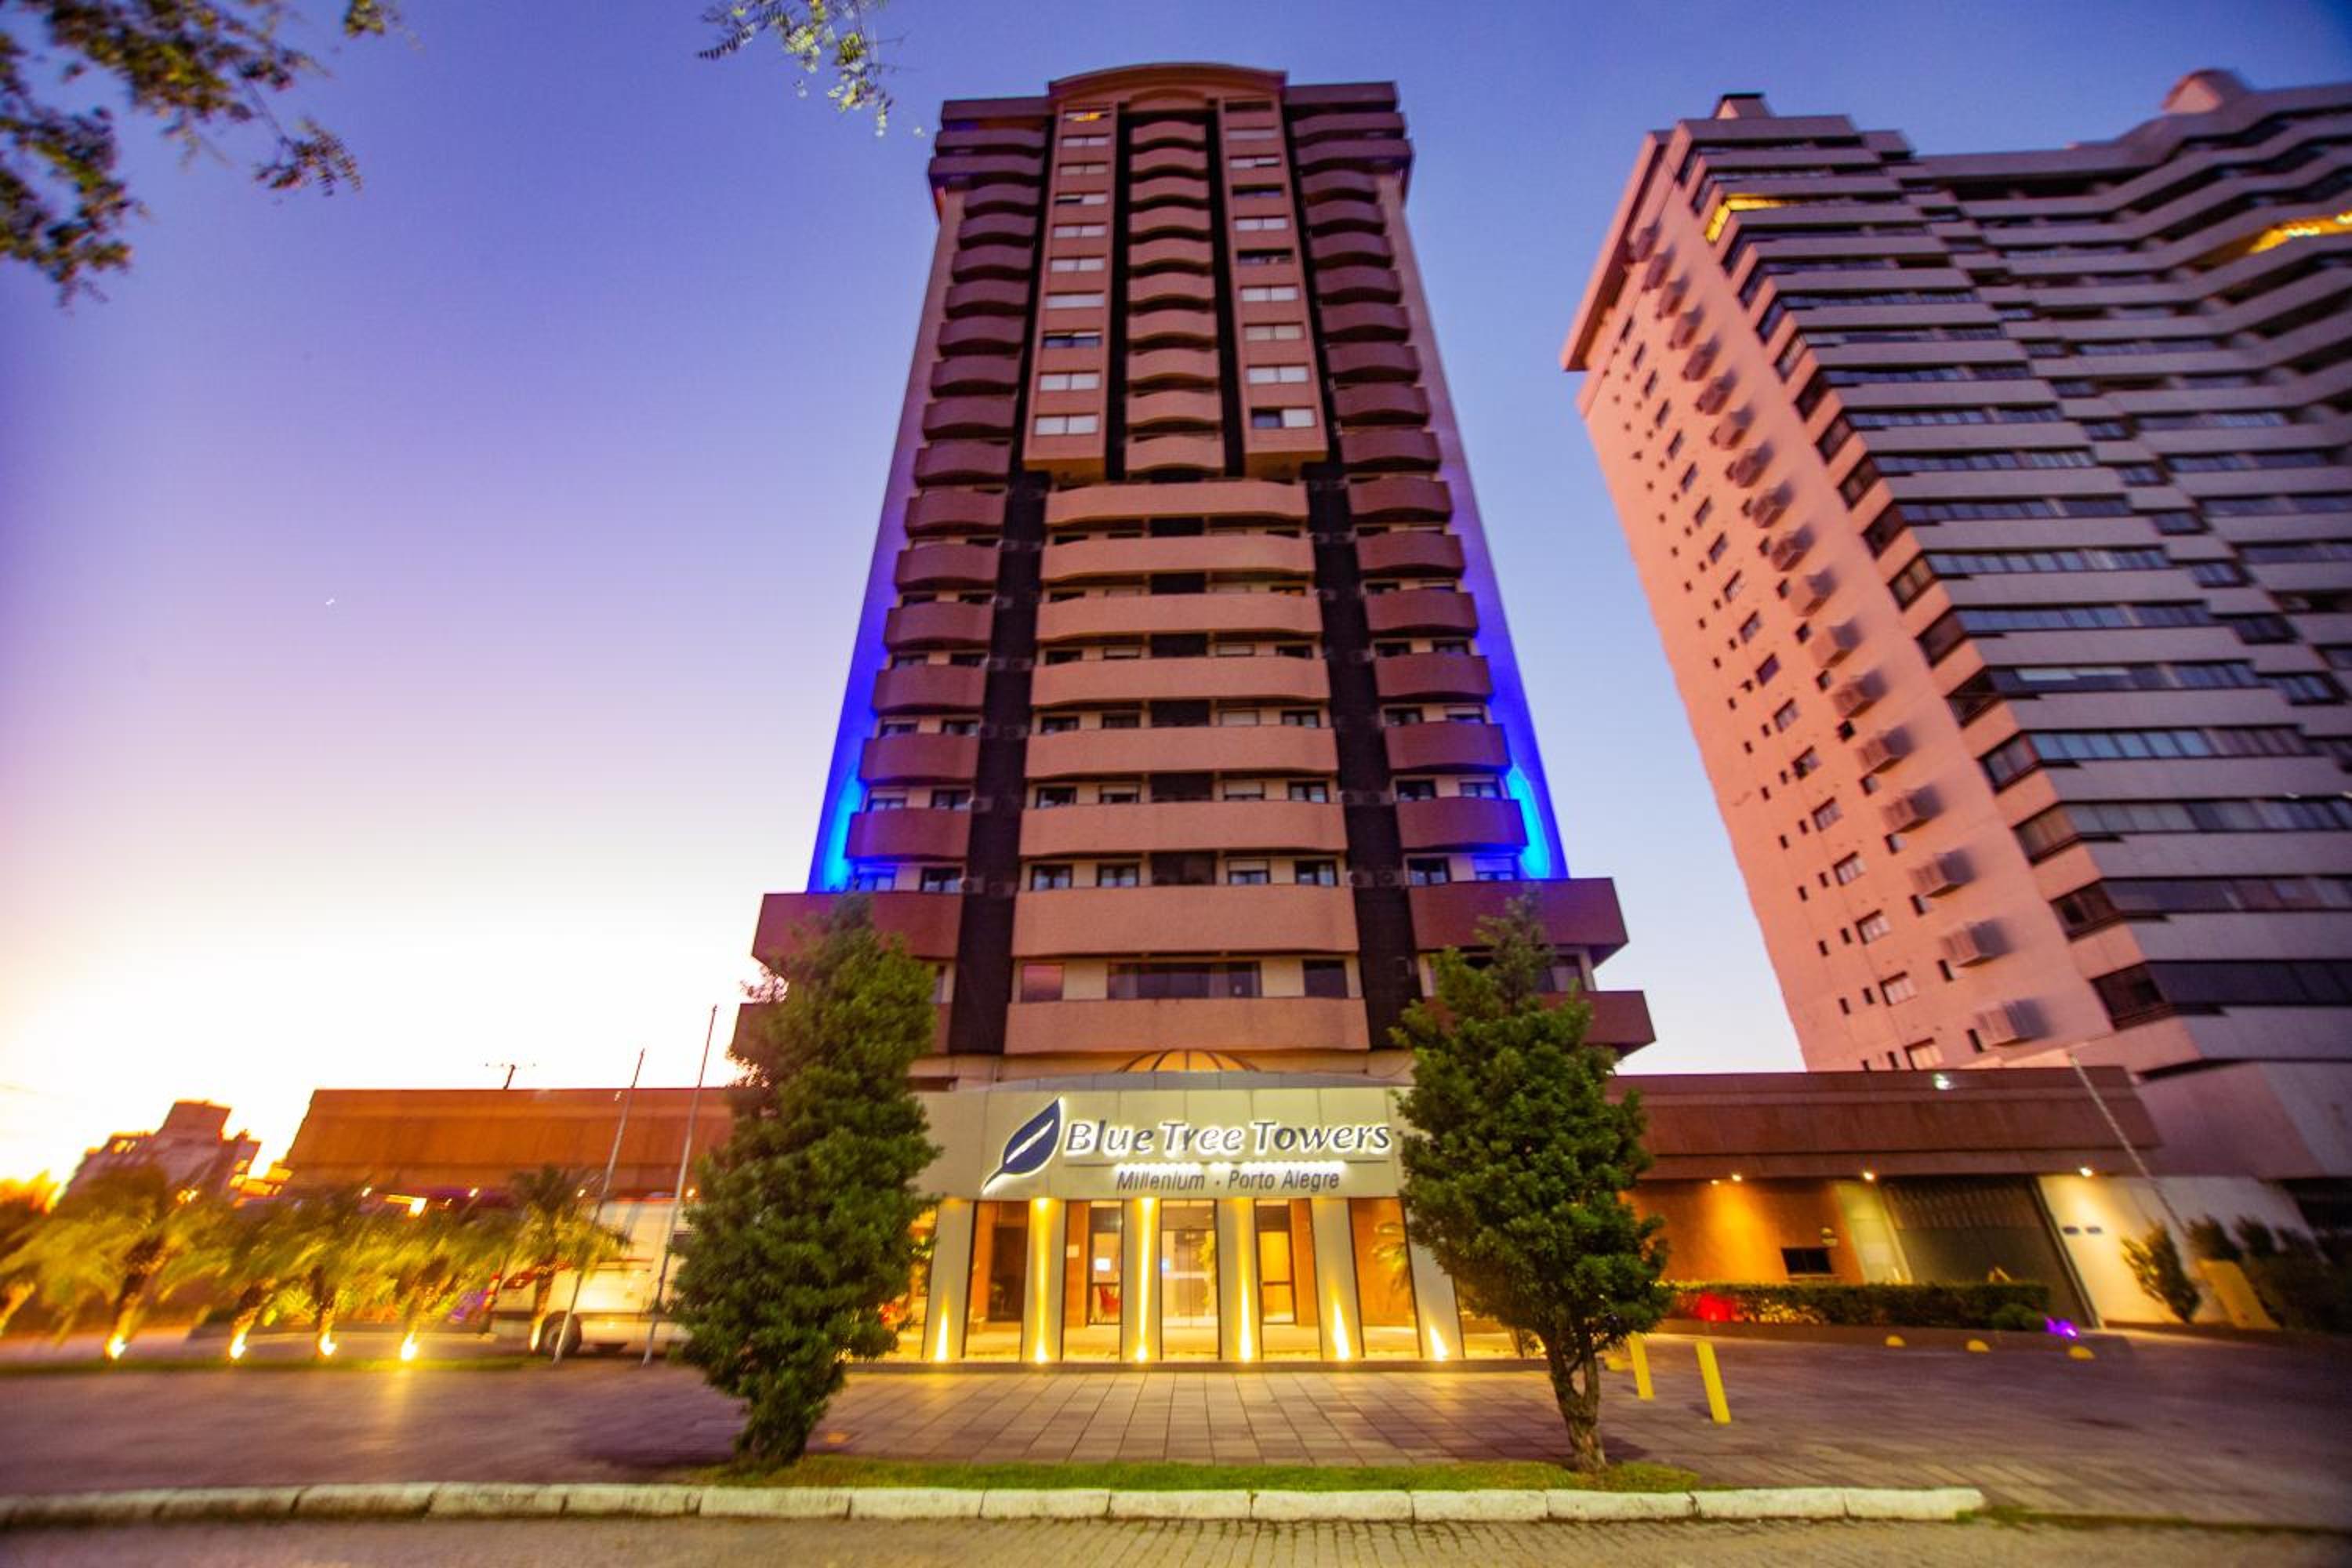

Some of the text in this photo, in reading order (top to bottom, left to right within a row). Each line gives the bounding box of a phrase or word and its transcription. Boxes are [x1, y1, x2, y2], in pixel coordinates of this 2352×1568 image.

[1065, 1120, 1392, 1152] Blue Tree Towers
[1116, 1169, 1340, 1192] Millenium Porto Alegre
